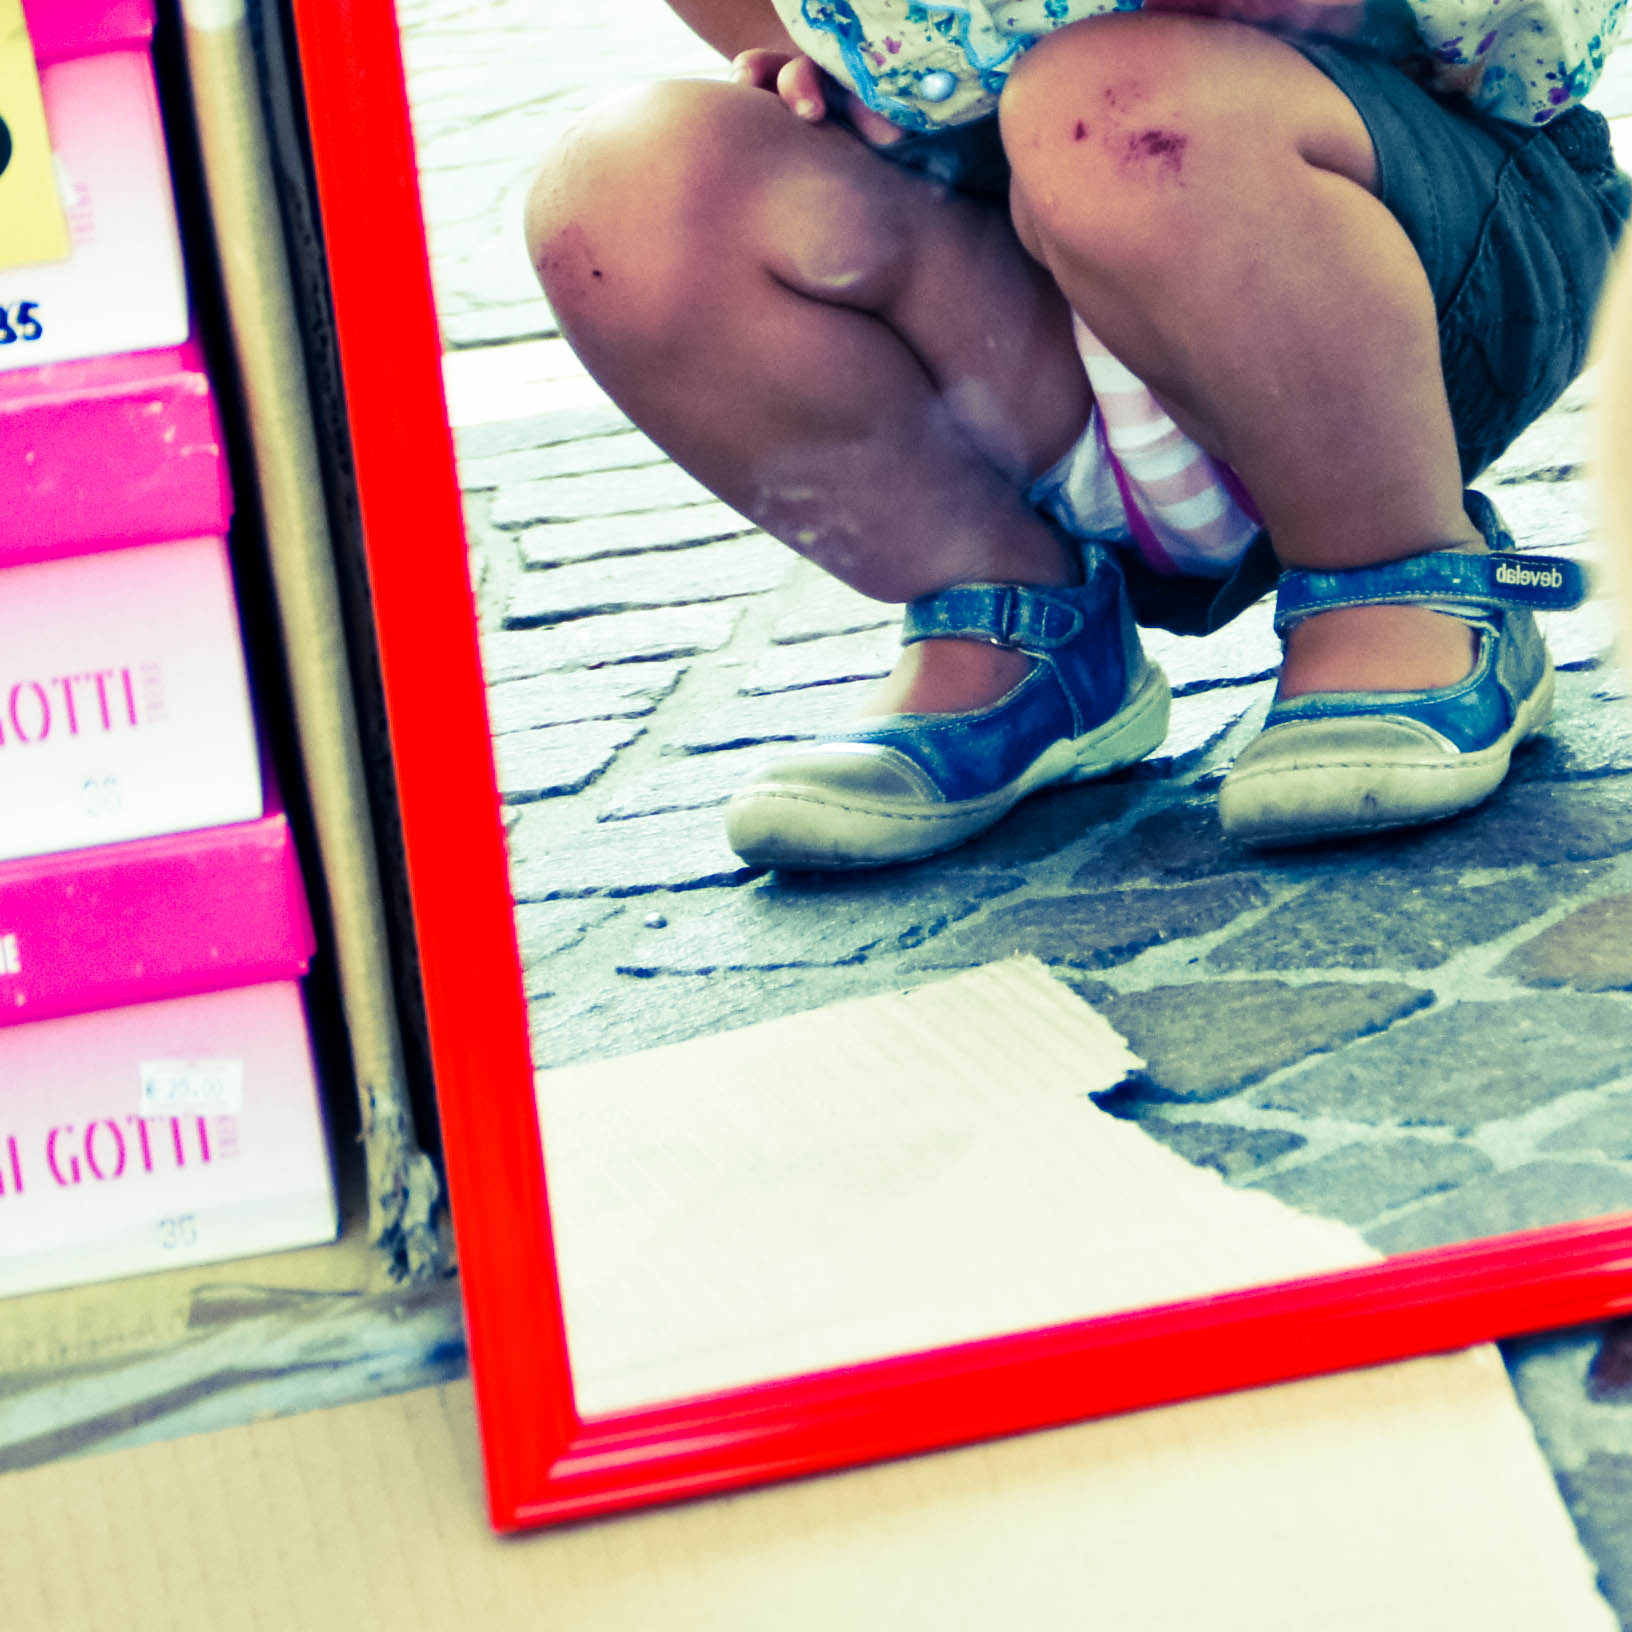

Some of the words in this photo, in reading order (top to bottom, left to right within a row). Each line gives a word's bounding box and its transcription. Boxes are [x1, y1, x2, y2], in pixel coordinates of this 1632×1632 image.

[0, 667, 138, 746] OTTI
[0, 1136, 23, 1195] I
[46, 1115, 211, 1186] GOTTI
